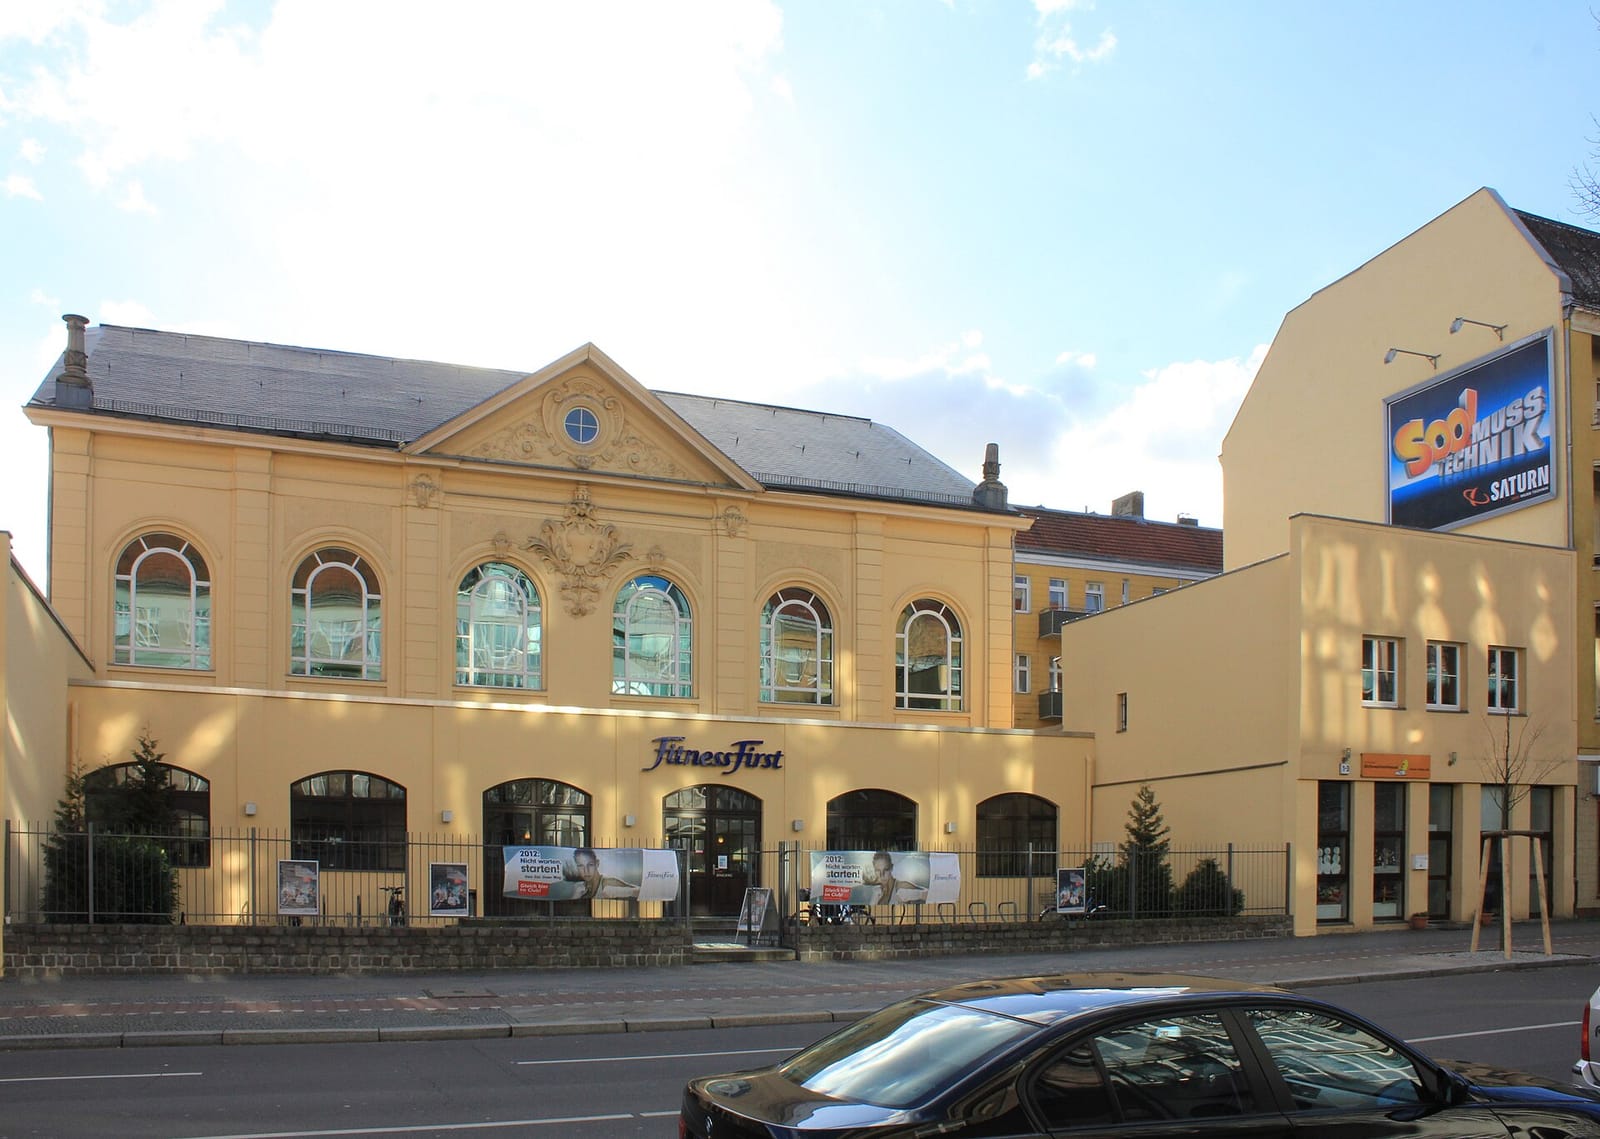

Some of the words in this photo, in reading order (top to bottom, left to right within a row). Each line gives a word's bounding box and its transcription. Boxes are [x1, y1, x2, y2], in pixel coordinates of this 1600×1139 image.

[1471, 386, 1546, 445] MUSS
[1437, 417, 1546, 476] TECHNIK
[1490, 464, 1549, 502] SATURN
[521, 865, 560, 873] starten!
[826, 870, 860, 878] starten!
